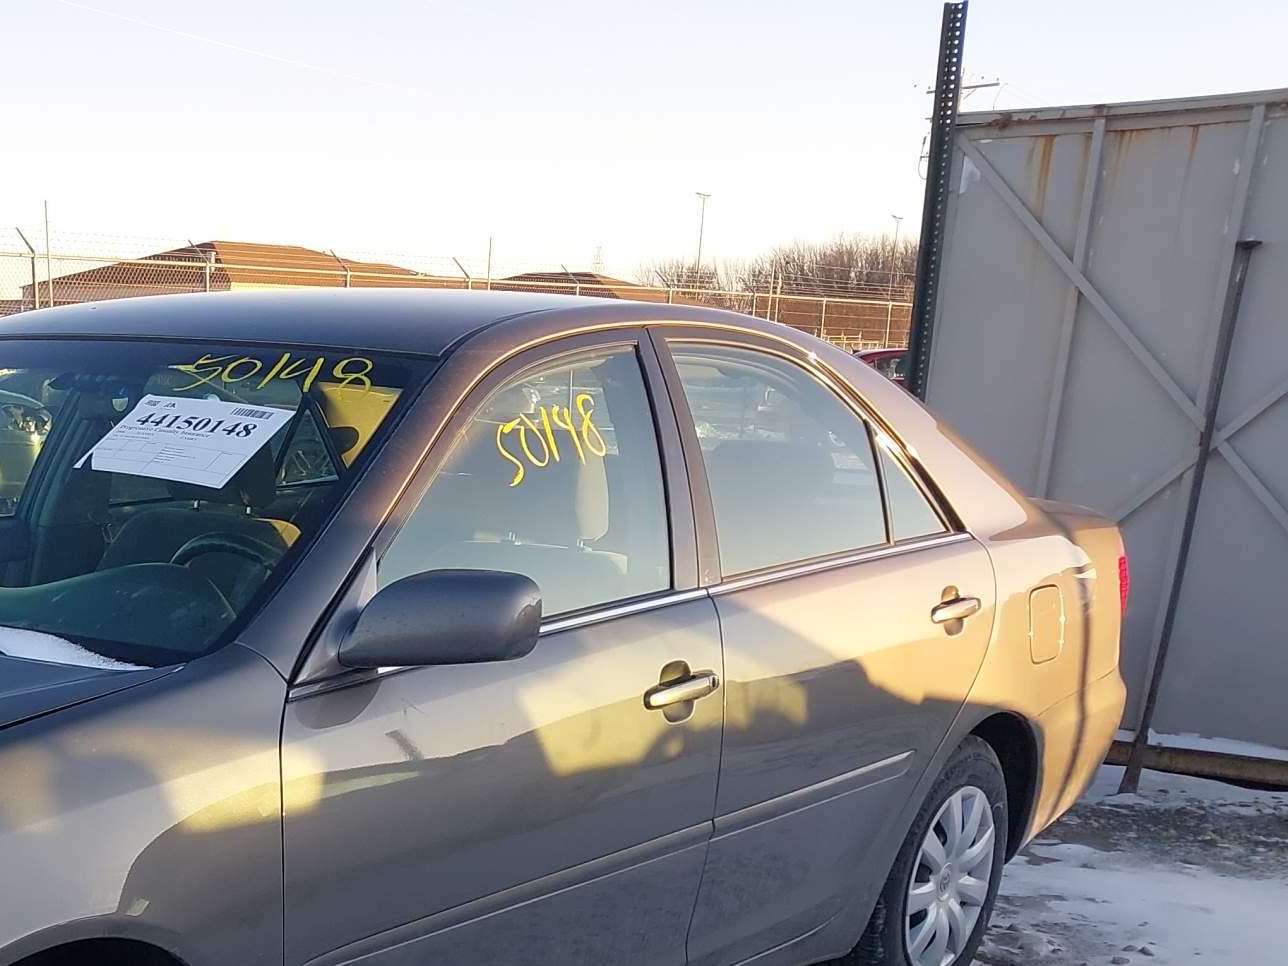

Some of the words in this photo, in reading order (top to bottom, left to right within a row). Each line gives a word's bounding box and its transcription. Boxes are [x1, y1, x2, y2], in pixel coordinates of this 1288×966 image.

[168, 353, 373, 398] 50148
[136, 412, 258, 438] 44150148
[496, 393, 606, 487] 50148
